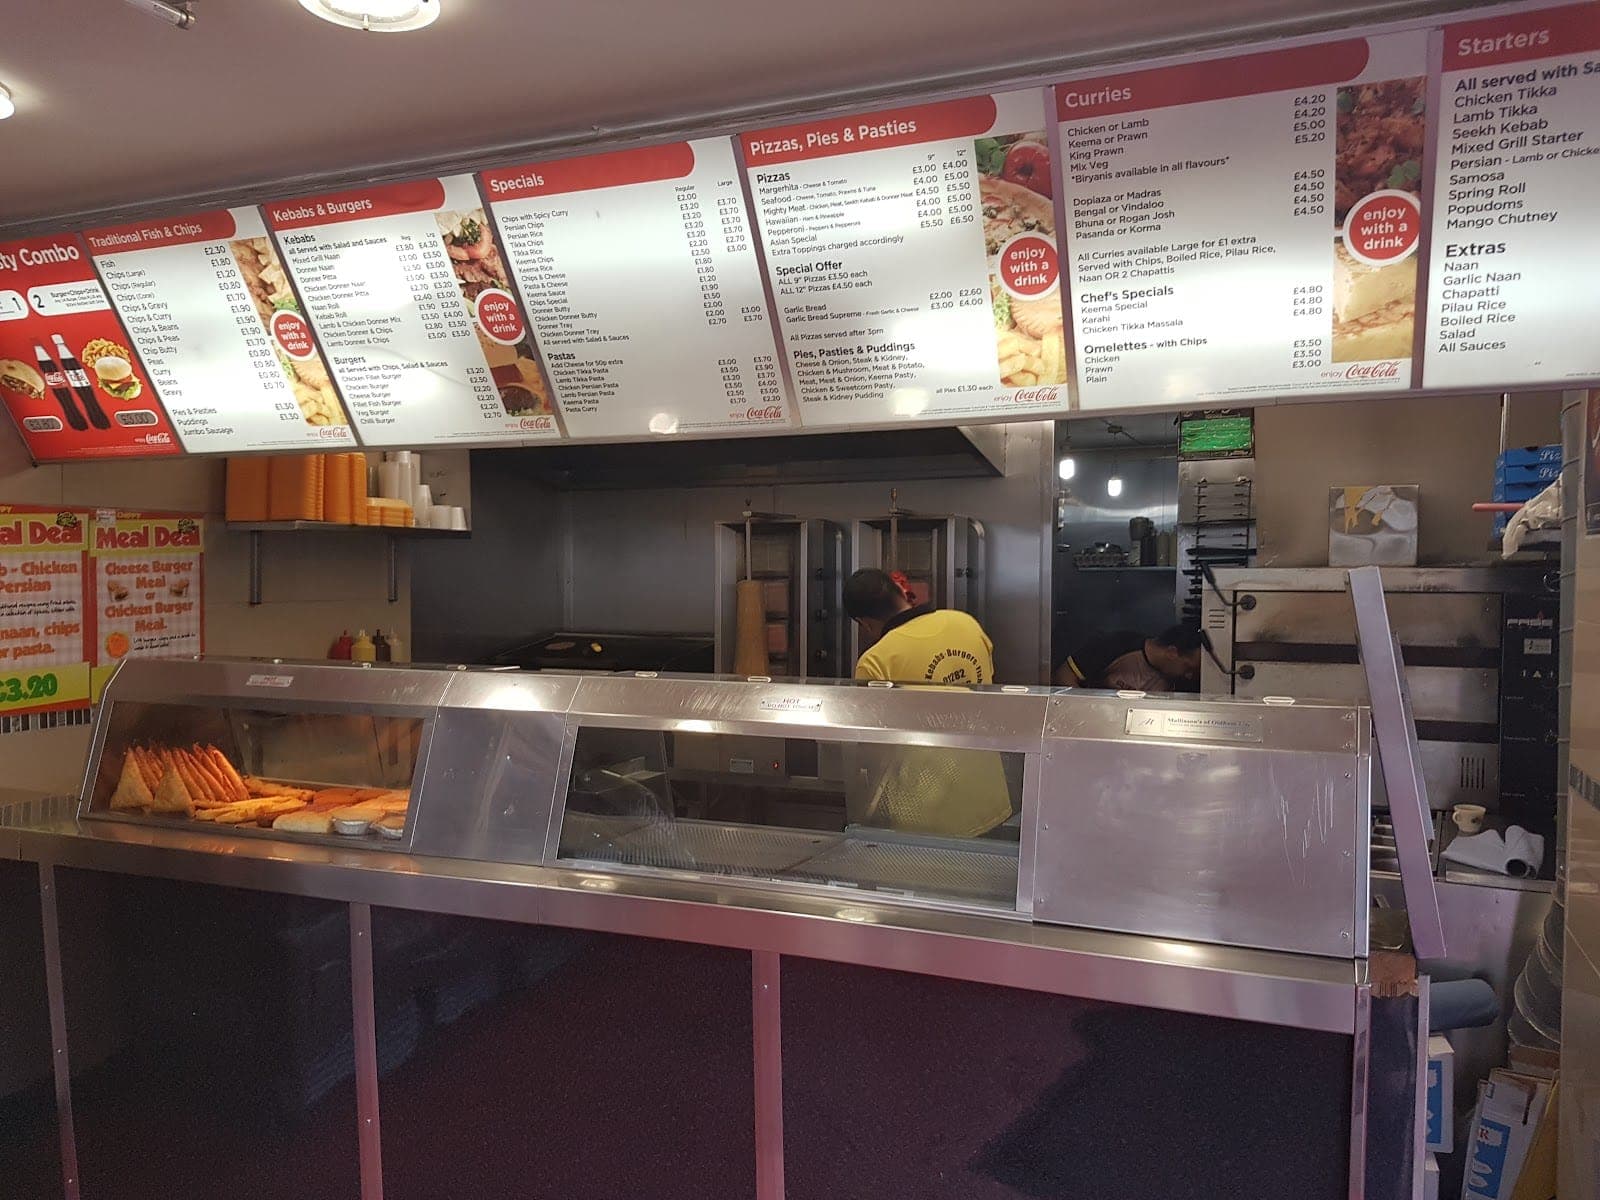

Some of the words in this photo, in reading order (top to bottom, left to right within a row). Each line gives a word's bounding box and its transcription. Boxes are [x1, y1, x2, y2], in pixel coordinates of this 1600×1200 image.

[1458, 30, 1549, 56] Starters
[1455, 77, 1476, 92] All
[1481, 69, 1536, 88] served
[1542, 64, 1577, 80] with
[1065, 86, 1131, 107] Curries
[1294, 94, 1325, 106] £4.20
[1454, 92, 1512, 107] Chicken
[1517, 85, 1556, 99] Tikka
[1294, 106, 1325, 119] £4.20
[1453, 108, 1494, 123] Lamb
[1499, 104, 1537, 117] Tikka
[1067, 125, 1105, 136] Chicken
[1108, 123, 1118, 131] or
[1121, 118, 1149, 129] Lamb
[1293, 119, 1325, 131] £5.00
[1452, 124, 1495, 139] Seekh
[1500, 118, 1548, 134] Kebab
[750, 139, 802, 155] Pizzas,
[806, 131, 838, 147] Pies
[843, 127, 854, 142] &
[858, 120, 916, 139] Pasties
[1068, 138, 1101, 148] Keema
[1117, 132, 1147, 142] Prawn
[1295, 132, 1325, 143] £5.20
[1451, 139, 1494, 154] Mixed
[1498, 135, 1527, 149] Grill
[1532, 131, 1583, 145] Starter
[1069, 151, 1090, 160] King
[1093, 147, 1123, 156] Prawn
[942, 159, 967, 169] £4.00
[1450, 156, 1501, 170] Persian
[1512, 152, 1543, 163] Lamb
[1546, 152, 1559, 160] or
[912, 163, 936, 174] £3.00
[944, 170, 968, 180] £5.00
[490, 173, 544, 193] Specials
[756, 172, 790, 184] Pizzas
[913, 175, 937, 185] £4.00
[1449, 172, 1504, 185] Samosa
[759, 183, 798, 194] Margerhita
[1449, 187, 1494, 201] Spring
[1498, 182, 1525, 195] Roll
[677, 192, 696, 201] £2.00
[717, 197, 736, 206] £3.70
[761, 194, 791, 205] Seafood
[273, 206, 315, 221] Kebabs
[316, 204, 326, 215] &
[326, 199, 372, 214] Burgers
[680, 202, 698, 210] £3.20
[1448, 200, 1522, 214] Popudoms
[533, 211, 550, 219] Spicy
[1363, 207, 1406, 221] enjoy
[1447, 218, 1493, 229] Mango
[1498, 211, 1557, 224] Chutney
[89, 228, 141, 248] Traditional
[142, 227, 163, 240] Fish
[164, 226, 172, 237] &
[173, 222, 202, 237] Chips
[1361, 222, 1394, 236] with
[1398, 222, 1408, 232] a
[283, 234, 315, 245] Kebabs
[418, 240, 438, 248] £4.30
[792, 245, 826, 254] Toppings
[827, 239, 858, 249] charged
[860, 235, 903, 246] accordingly
[1364, 236, 1404, 250] drink
[19, 243, 79, 265] Combo
[204, 245, 225, 255] £2.30
[1010, 248, 1046, 260] enjoy
[1446, 243, 1505, 257] Extras
[99, 259, 115, 268] Fish
[211, 257, 230, 267] £1.80
[776, 263, 812, 276] Special
[815, 260, 842, 271] Offer
[1010, 261, 1037, 274] with
[1042, 261, 1049, 270] a
[1444, 262, 1478, 272] Naan
[216, 269, 235, 278] £1.20
[1443, 274, 1481, 285] Garlic
[1486, 272, 1520, 282] Naan
[1014, 274, 1048, 287] drink
[1081, 291, 1118, 303] Chef's
[1122, 285, 1173, 300] Specials
[1442, 285, 1499, 299] Chapatti
[33, 294, 45, 309] 2
[484, 301, 509, 312] enjoy
[1441, 302, 1472, 312] Pilau
[1477, 300, 1506, 310] Rice
[486, 313, 507, 323] with
[1440, 314, 1482, 326] Boiled
[1486, 313, 1515, 323] Rice
[278, 321, 300, 331] enjoy
[492, 323, 518, 333] drink
[281, 332, 298, 340] with
[1439, 328, 1475, 339] Salad
[287, 341, 309, 350] drink
[793, 349, 816, 359] Pies,
[818, 347, 854, 357] Pasties
[856, 345, 863, 354] &
[866, 342, 915, 353] Puddings
[1084, 342, 1146, 353] Omelettes
[1156, 339, 1177, 347] with
[1180, 337, 1207, 346] Chips
[1438, 342, 1455, 352] All
[1460, 341, 1505, 351] Sauces
[333, 356, 365, 365] Burgers
[547, 352, 575, 360] Pastas
[29, 520, 82, 545] Deal
[96, 526, 149, 549] Meal
[154, 525, 201, 547] Deal
[21, 560, 78, 576] Chicken
[105, 562, 150, 576] Cheese
[152, 561, 193, 575] Burger
[136, 576, 166, 589] Meal
[145, 591, 156, 600] or
[105, 603, 153, 619] Chicken
[155, 601, 194, 615] Burger
[44, 621, 80, 637] chips
[13, 643, 55, 660] pasta.
[925, 652, 945, 680] Kebabs
[946, 648, 978, 666] Burgers
